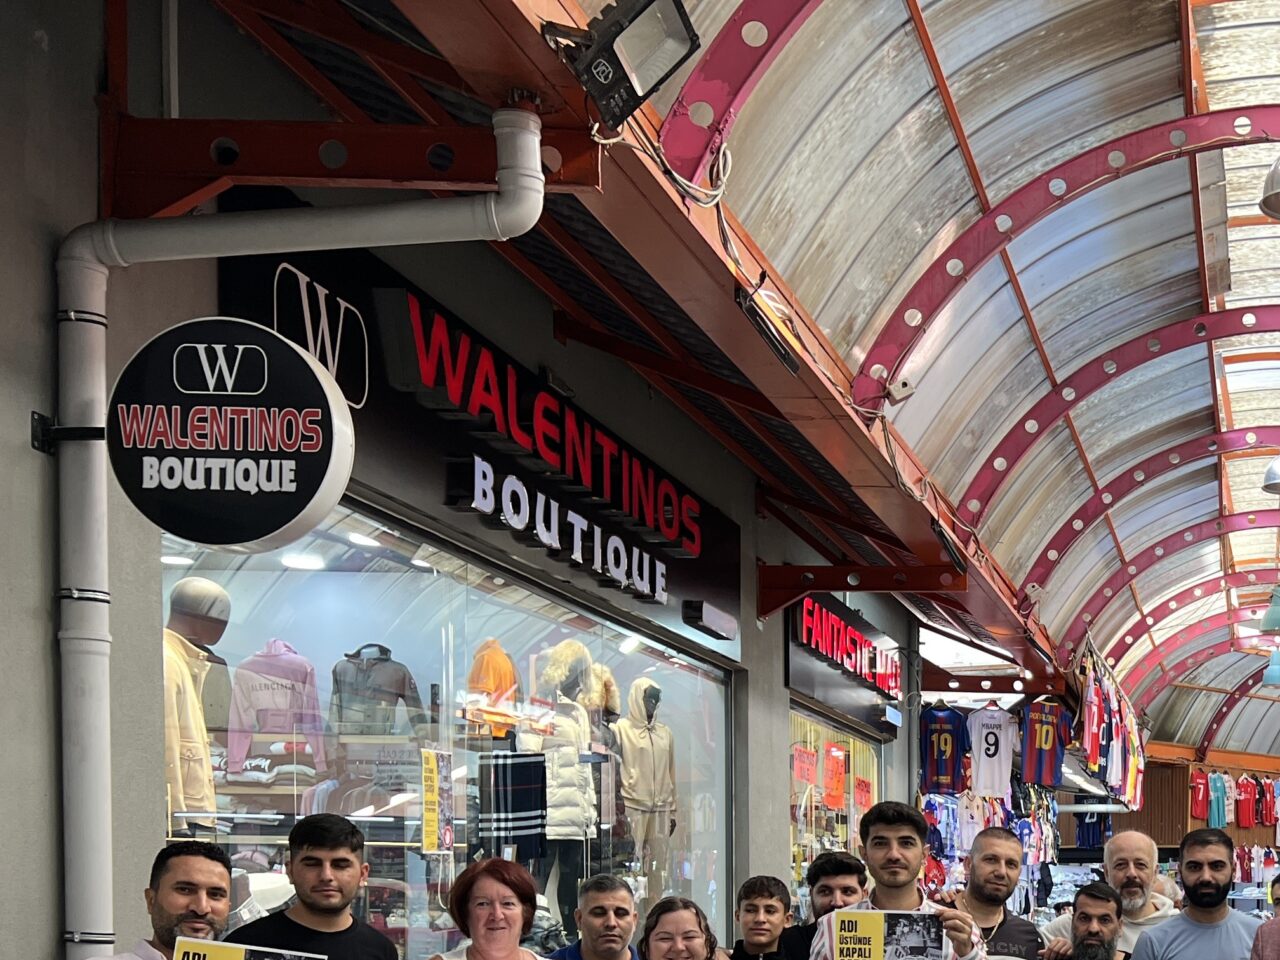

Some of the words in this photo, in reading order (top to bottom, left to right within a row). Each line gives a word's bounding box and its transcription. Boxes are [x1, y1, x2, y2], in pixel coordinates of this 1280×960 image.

[118, 404, 322, 453] WALENTINOS
[407, 293, 701, 557] WALENTINOS
[142, 456, 296, 495] BOUTIQUE
[471, 453, 668, 605] BOUTIQUE
[803, 597, 875, 682] FANTASTIC
[931, 733, 953, 760] 19
[984, 731, 999, 758] 9
[1034, 724, 1054, 750] 10
[839, 920, 858, 933] ADI
[839, 934, 872, 946] ÜSTÜNDE
[839, 947, 872, 959] KAPALI
